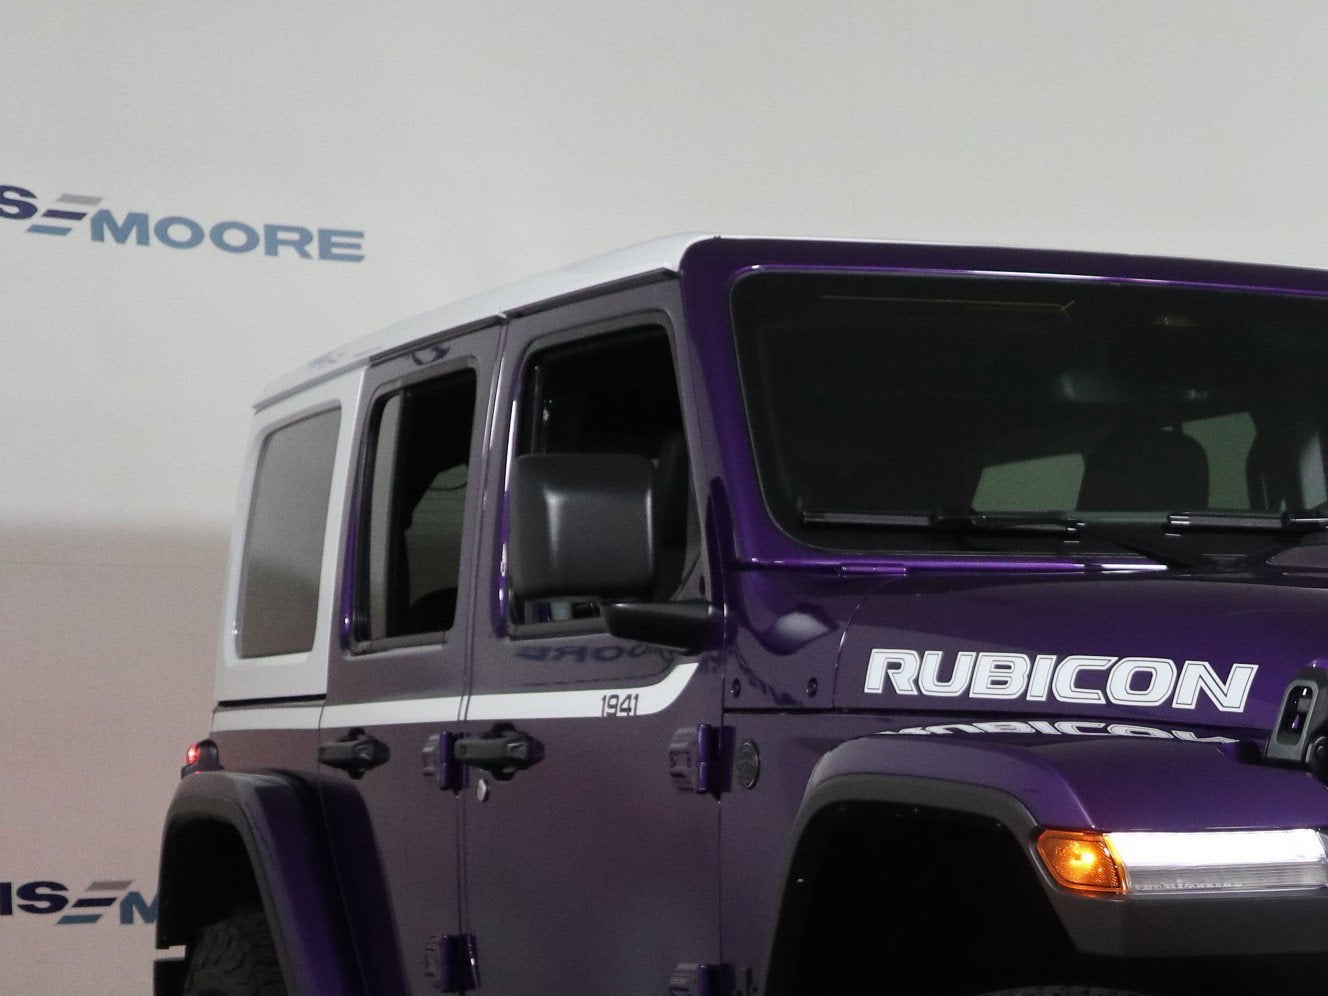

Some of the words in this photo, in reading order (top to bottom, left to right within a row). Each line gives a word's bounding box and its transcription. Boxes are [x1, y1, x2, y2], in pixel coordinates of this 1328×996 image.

[90, 209, 365, 262] MOORE
[601, 693, 639, 718] 1941
[864, 648, 1258, 713] RUBICON
